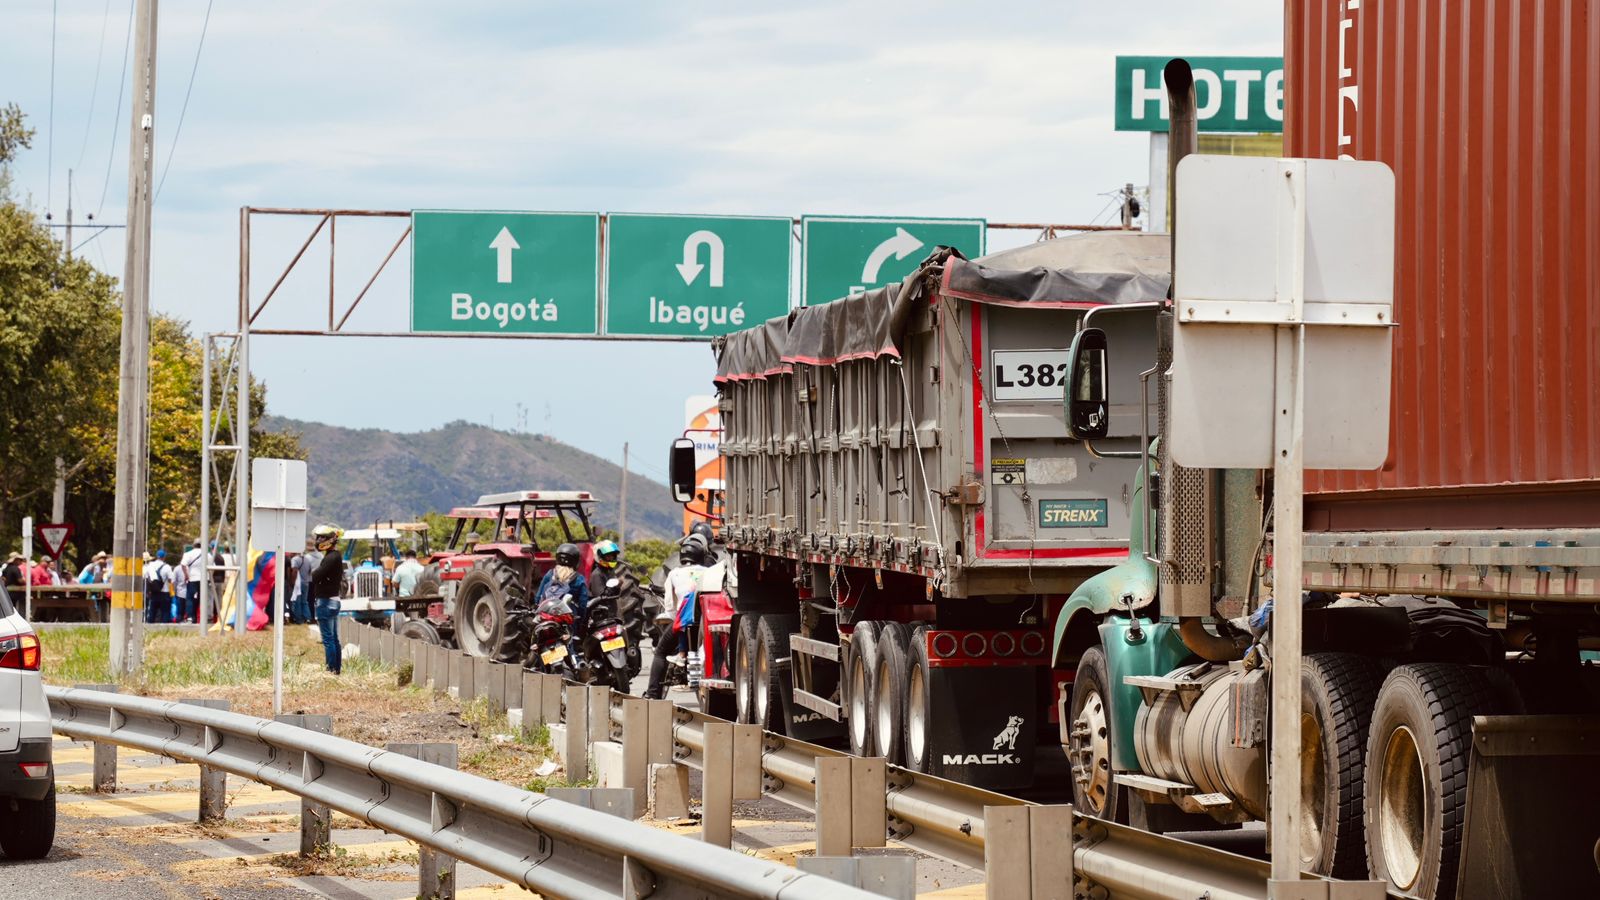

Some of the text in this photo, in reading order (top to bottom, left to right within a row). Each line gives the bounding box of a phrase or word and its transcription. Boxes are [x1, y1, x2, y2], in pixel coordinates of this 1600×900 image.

[451, 293, 558, 328] Bogotá
[649, 296, 745, 332] Ibagué
[1043, 509, 1099, 522] STRENX
[792, 712, 826, 723] MA
[942, 754, 1014, 765] MACK
